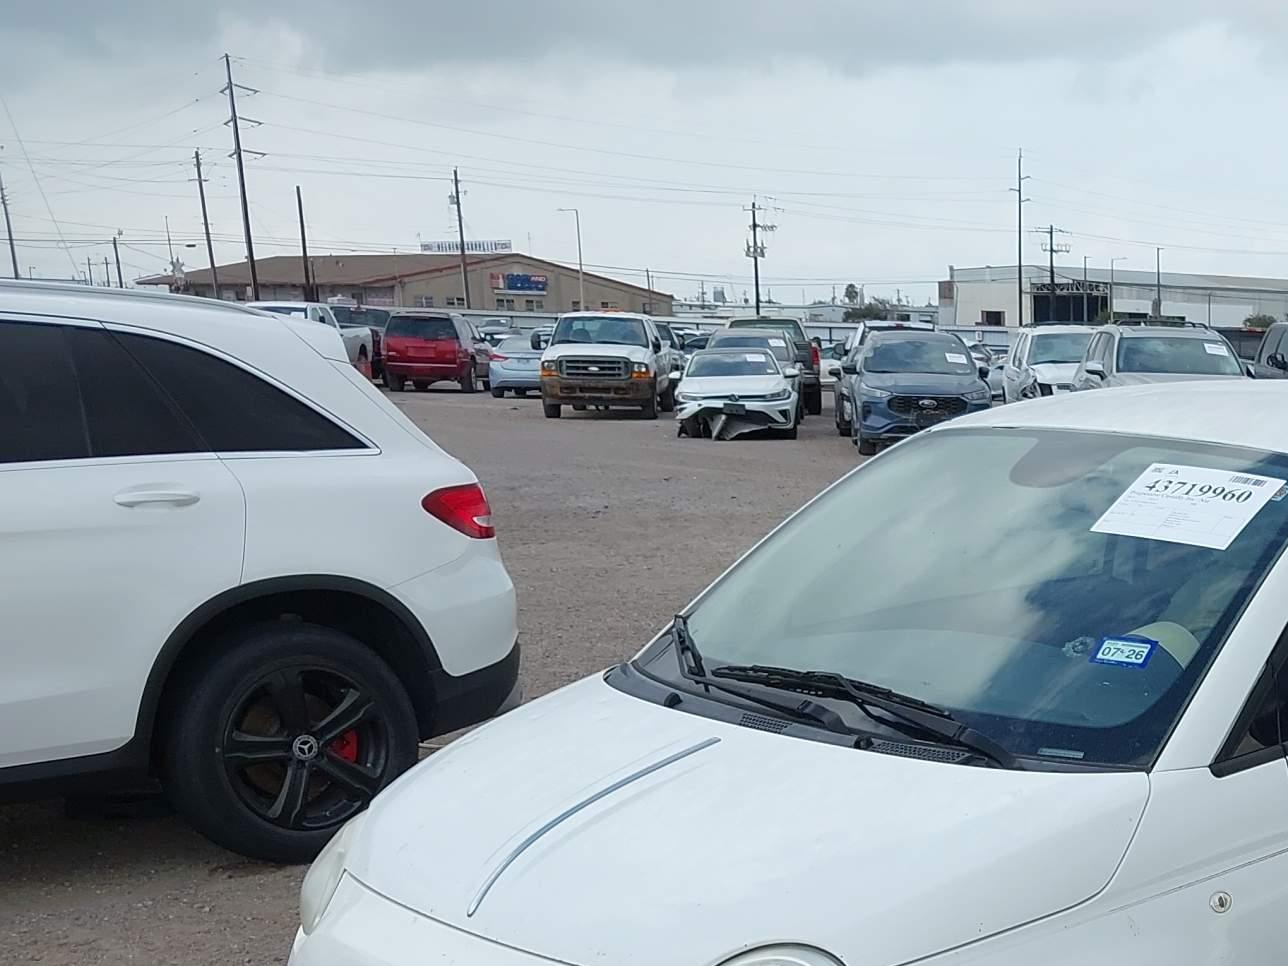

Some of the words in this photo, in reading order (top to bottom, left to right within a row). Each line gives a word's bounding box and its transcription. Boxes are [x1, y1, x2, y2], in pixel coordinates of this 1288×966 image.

[1145, 479, 1253, 503] 43719960
[1101, 646, 1122, 657] 07
[1125, 649, 1145, 660] 26
